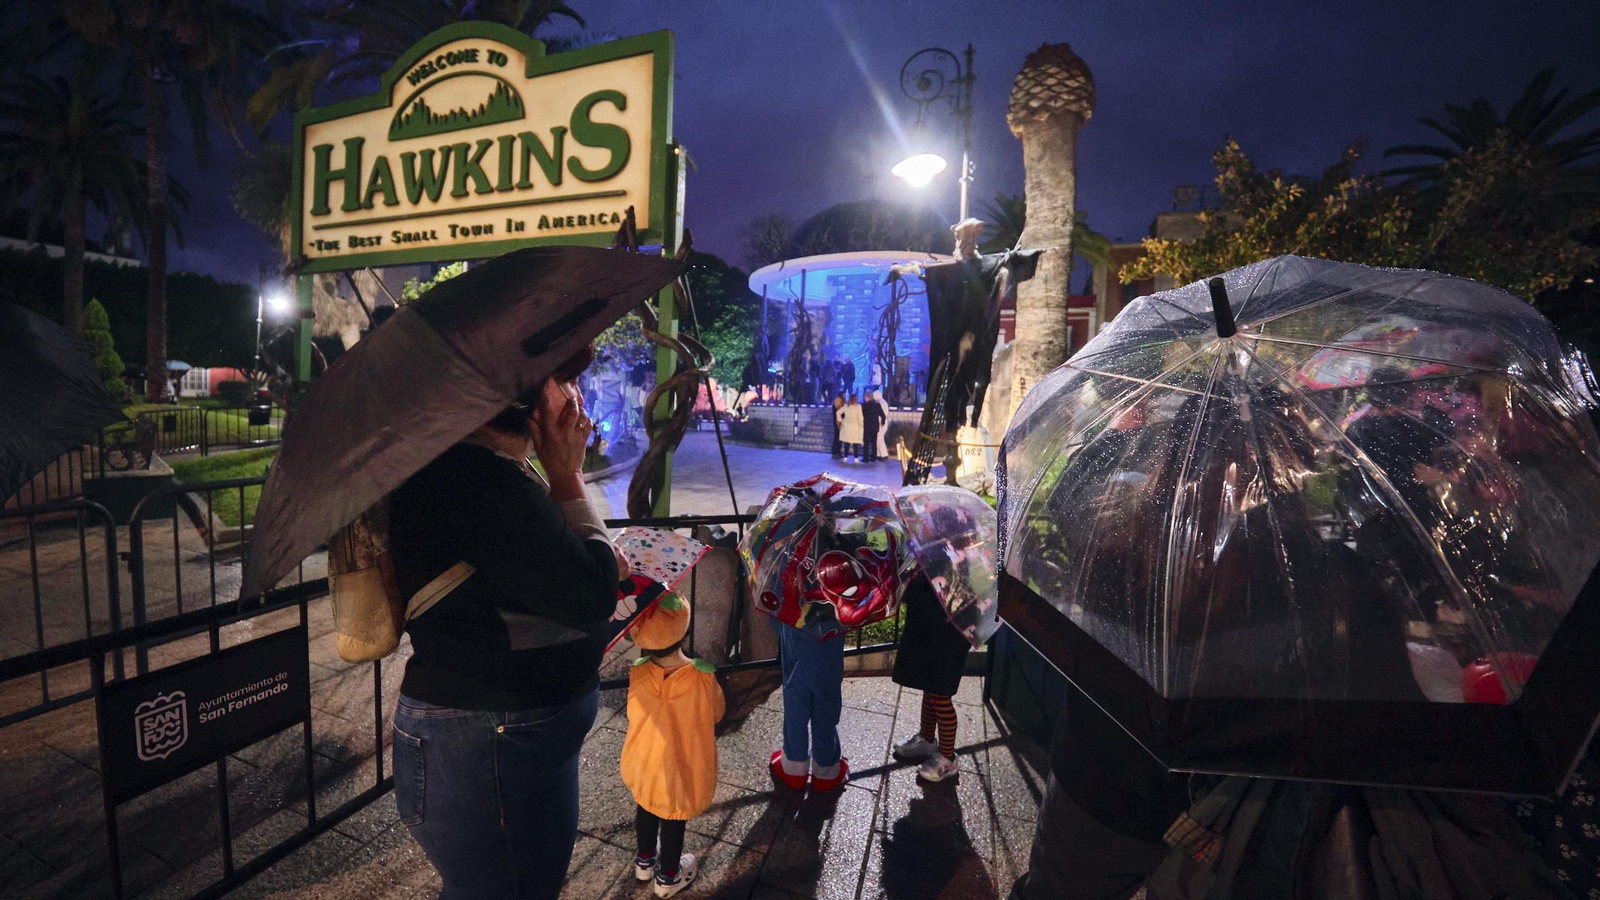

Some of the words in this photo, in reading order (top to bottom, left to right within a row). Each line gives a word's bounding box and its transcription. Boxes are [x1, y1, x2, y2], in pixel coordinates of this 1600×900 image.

[406, 48, 479, 86] WELCOME
[486, 48, 508, 67] TO
[310, 89, 631, 216] HAWKINS
[198, 677, 273, 711] Ayuntamiento
[274, 671, 288, 682] de
[199, 707, 226, 724] San
[228, 682, 289, 713] Fernando
[143, 707, 180, 731] SAN
